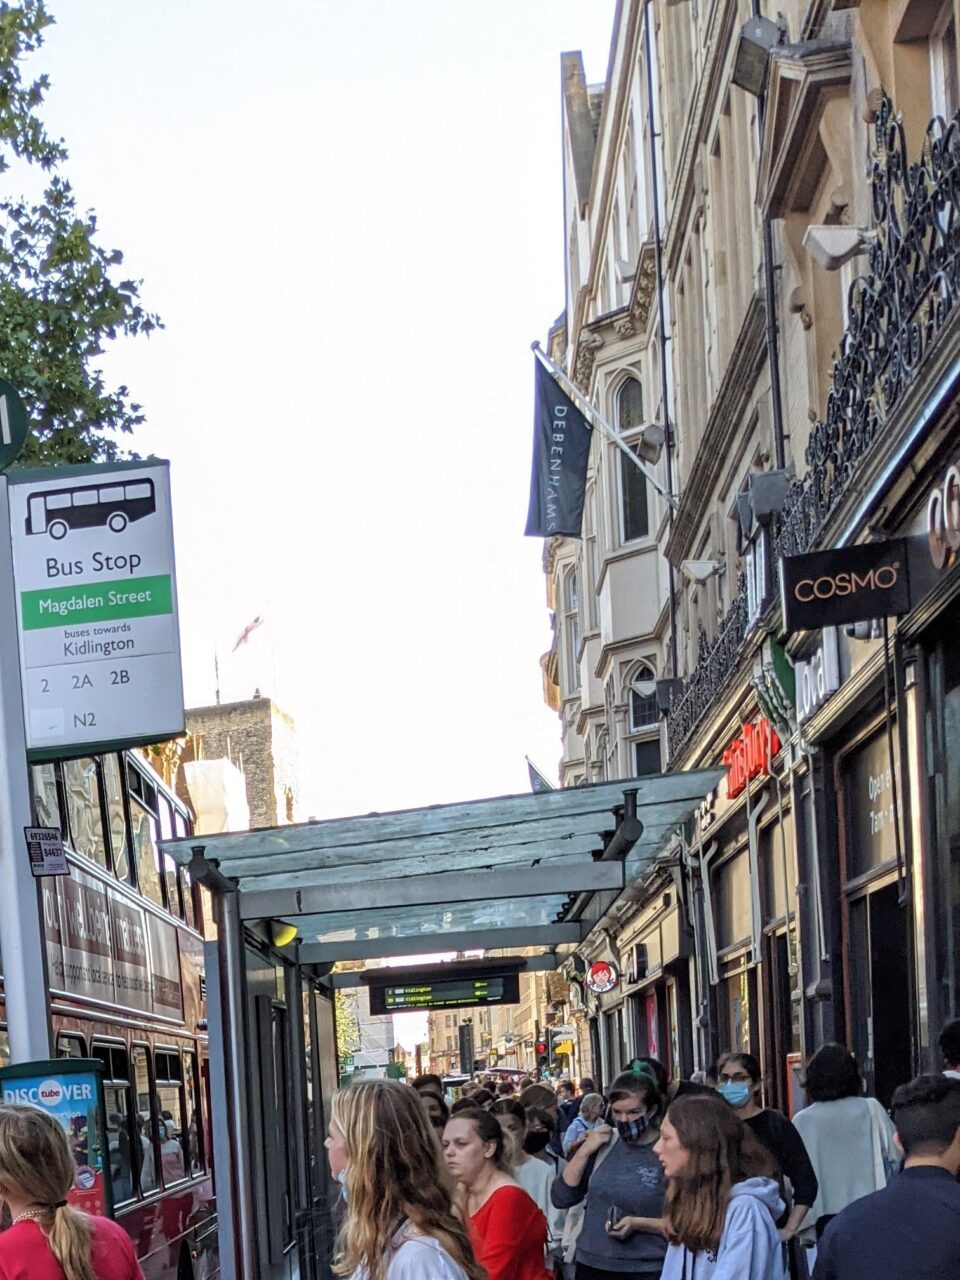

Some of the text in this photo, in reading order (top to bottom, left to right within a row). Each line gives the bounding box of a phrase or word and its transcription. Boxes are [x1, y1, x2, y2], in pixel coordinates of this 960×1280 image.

[546, 405, 568, 532] DEBENHAMS
[46, 551, 141, 578] Bus Stop
[795, 566, 897, 602] COSMO
[39, 590, 152, 616] Magdalen Street
[64, 622, 132, 639] buses towards
[63, 638, 135, 657] Kidlington
[40, 669, 131, 693] 2 2A 2B
[73, 712, 97, 729] N2
[41, 1089, 61, 1098] tube
